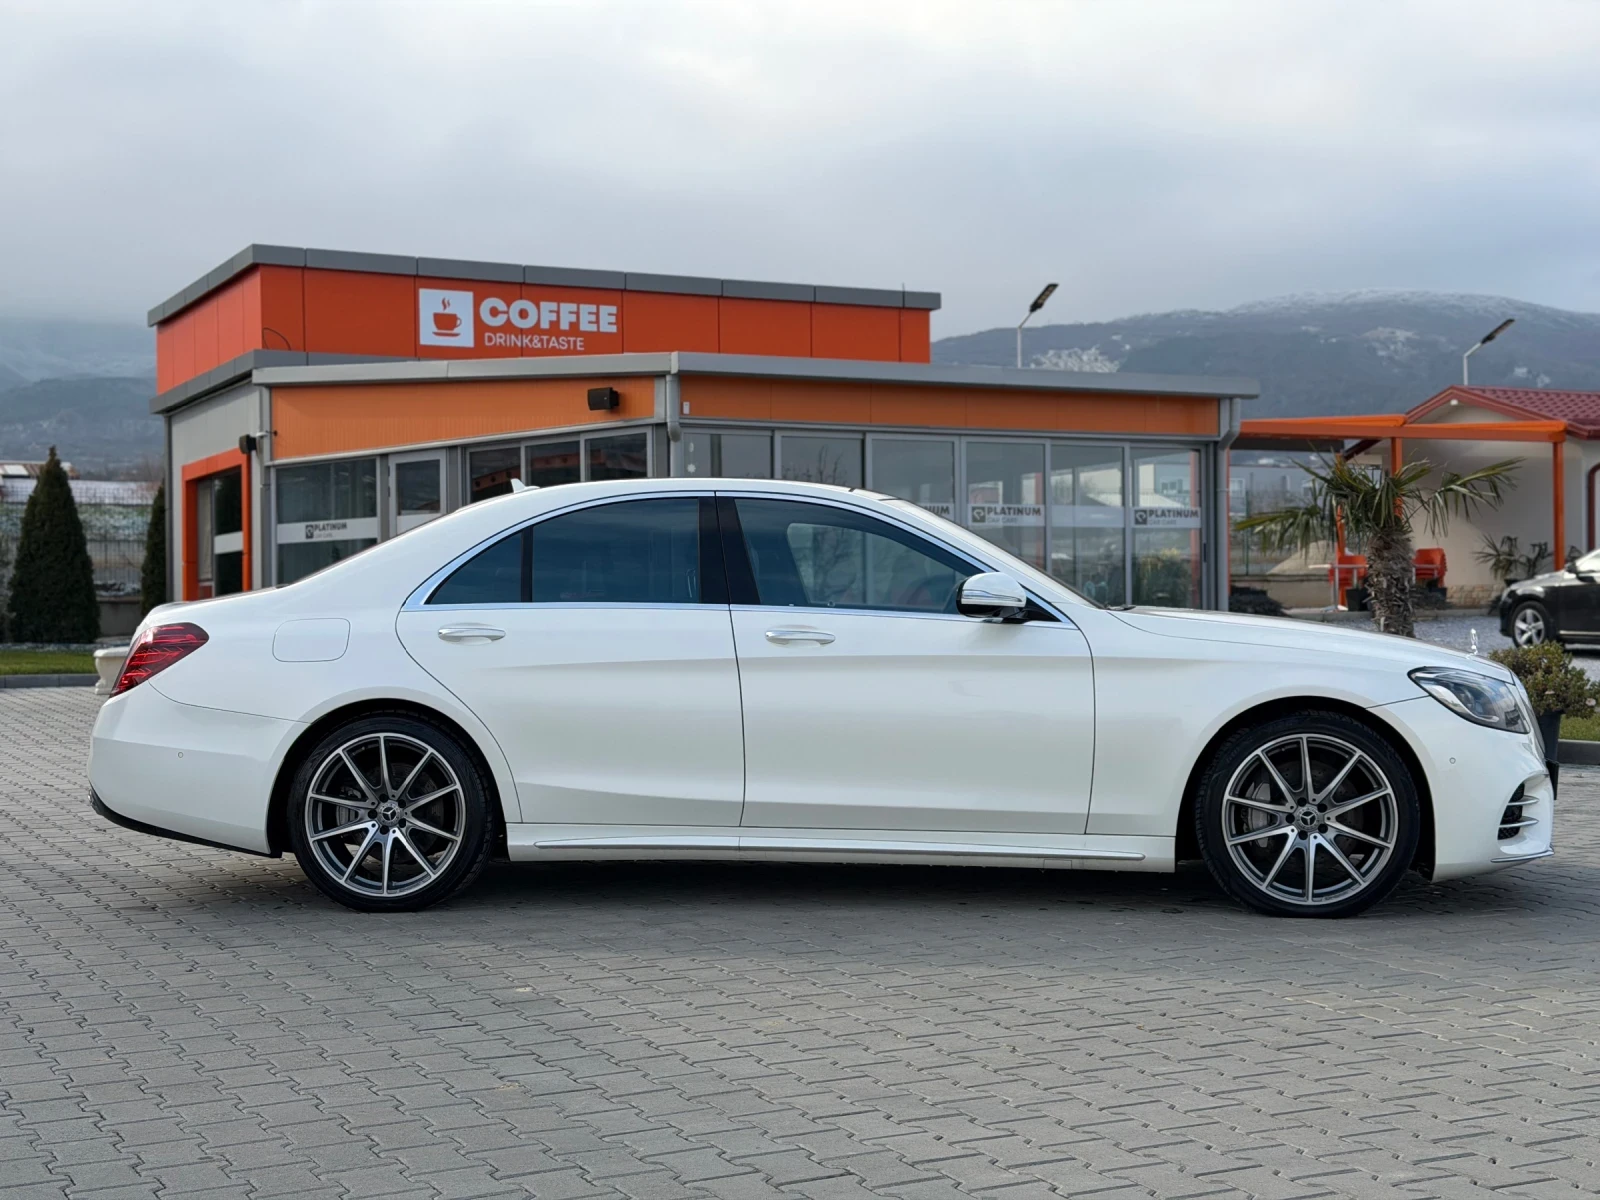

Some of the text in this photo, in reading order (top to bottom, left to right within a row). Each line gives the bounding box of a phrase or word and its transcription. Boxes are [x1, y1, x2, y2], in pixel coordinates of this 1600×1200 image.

[479, 297, 617, 332] COFFEE
[484, 332, 585, 350] DRINK&TASTE
[987, 506, 1042, 516] PLATINUM
[1149, 509, 1200, 518] PLATINUM
[314, 522, 347, 531] PLATINUM
